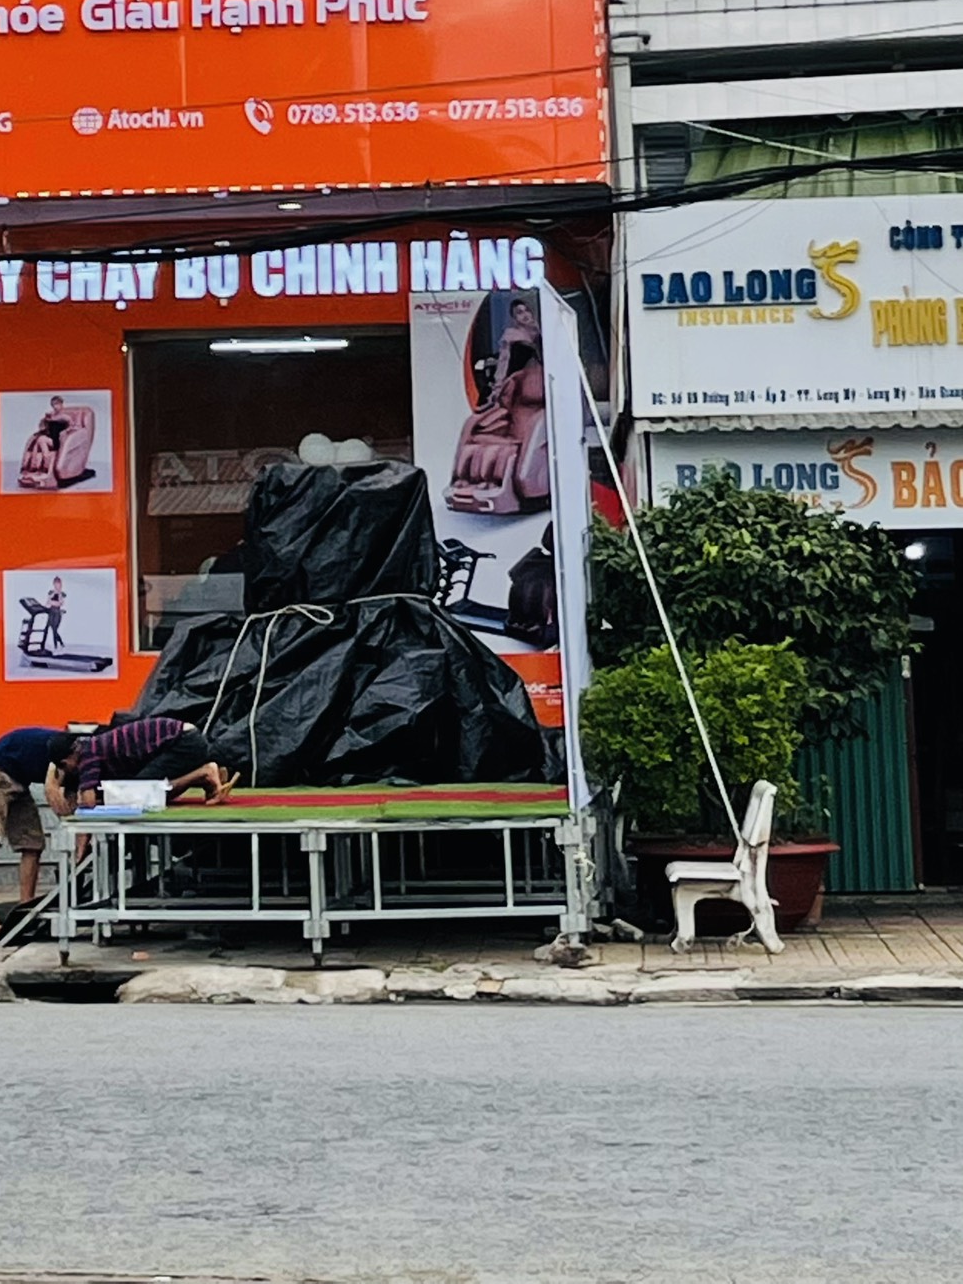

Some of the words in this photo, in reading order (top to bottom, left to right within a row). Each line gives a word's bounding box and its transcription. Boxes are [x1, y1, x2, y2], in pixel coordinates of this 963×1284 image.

[287, 101, 419, 124] 0789.513.636
[447, 97, 584, 120] 0777.513.636
[409, 229, 545, 292] HÃNG
[641, 271, 712, 304] BAO
[723, 268, 817, 303] LONG
